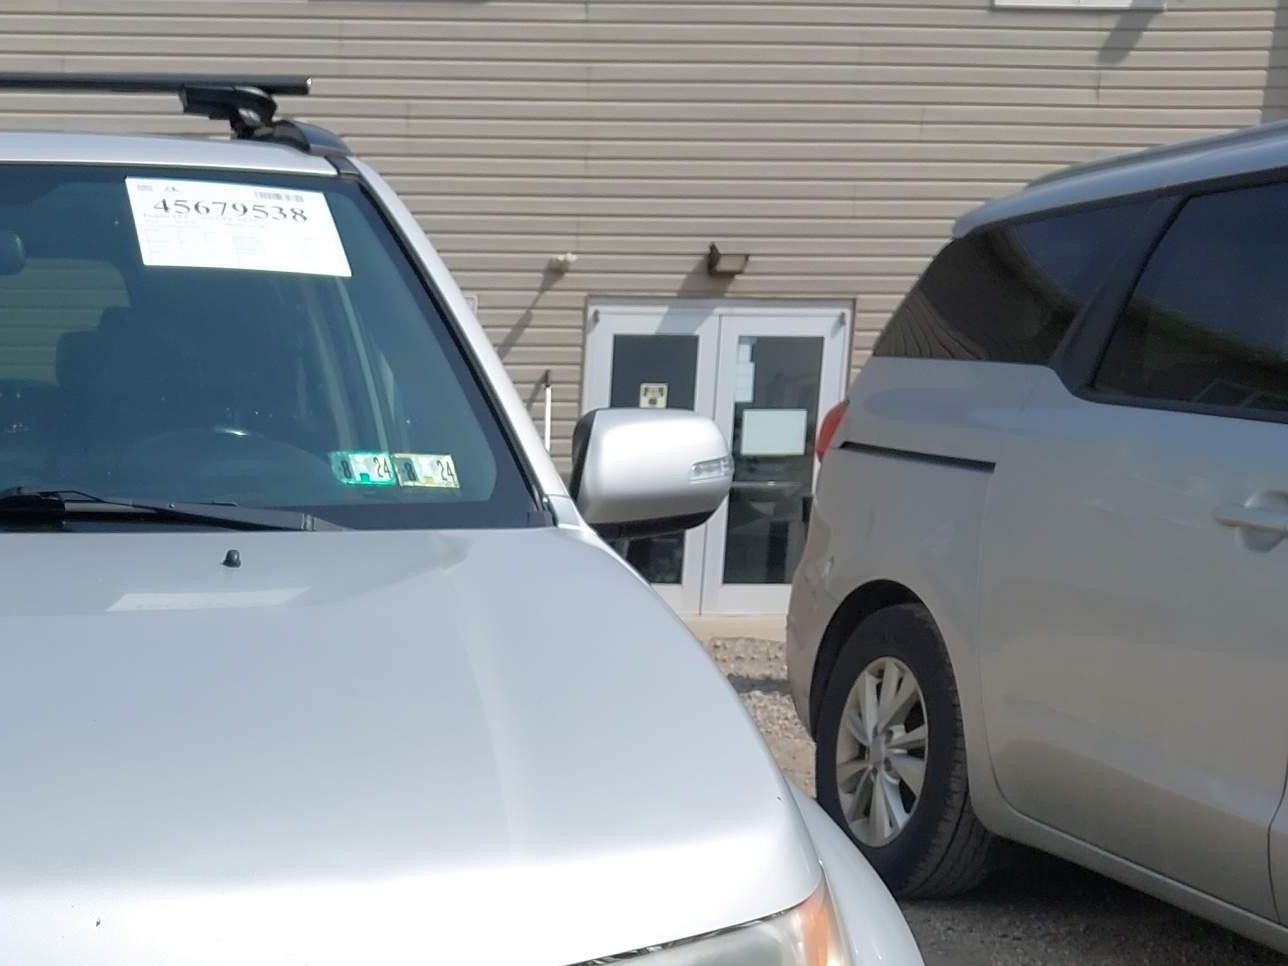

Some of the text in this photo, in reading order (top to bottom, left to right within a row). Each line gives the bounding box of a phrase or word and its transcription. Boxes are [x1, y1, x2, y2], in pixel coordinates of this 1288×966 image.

[152, 197, 309, 223] 45679538
[373, 456, 392, 480] 24
[436, 459, 456, 483] 24
